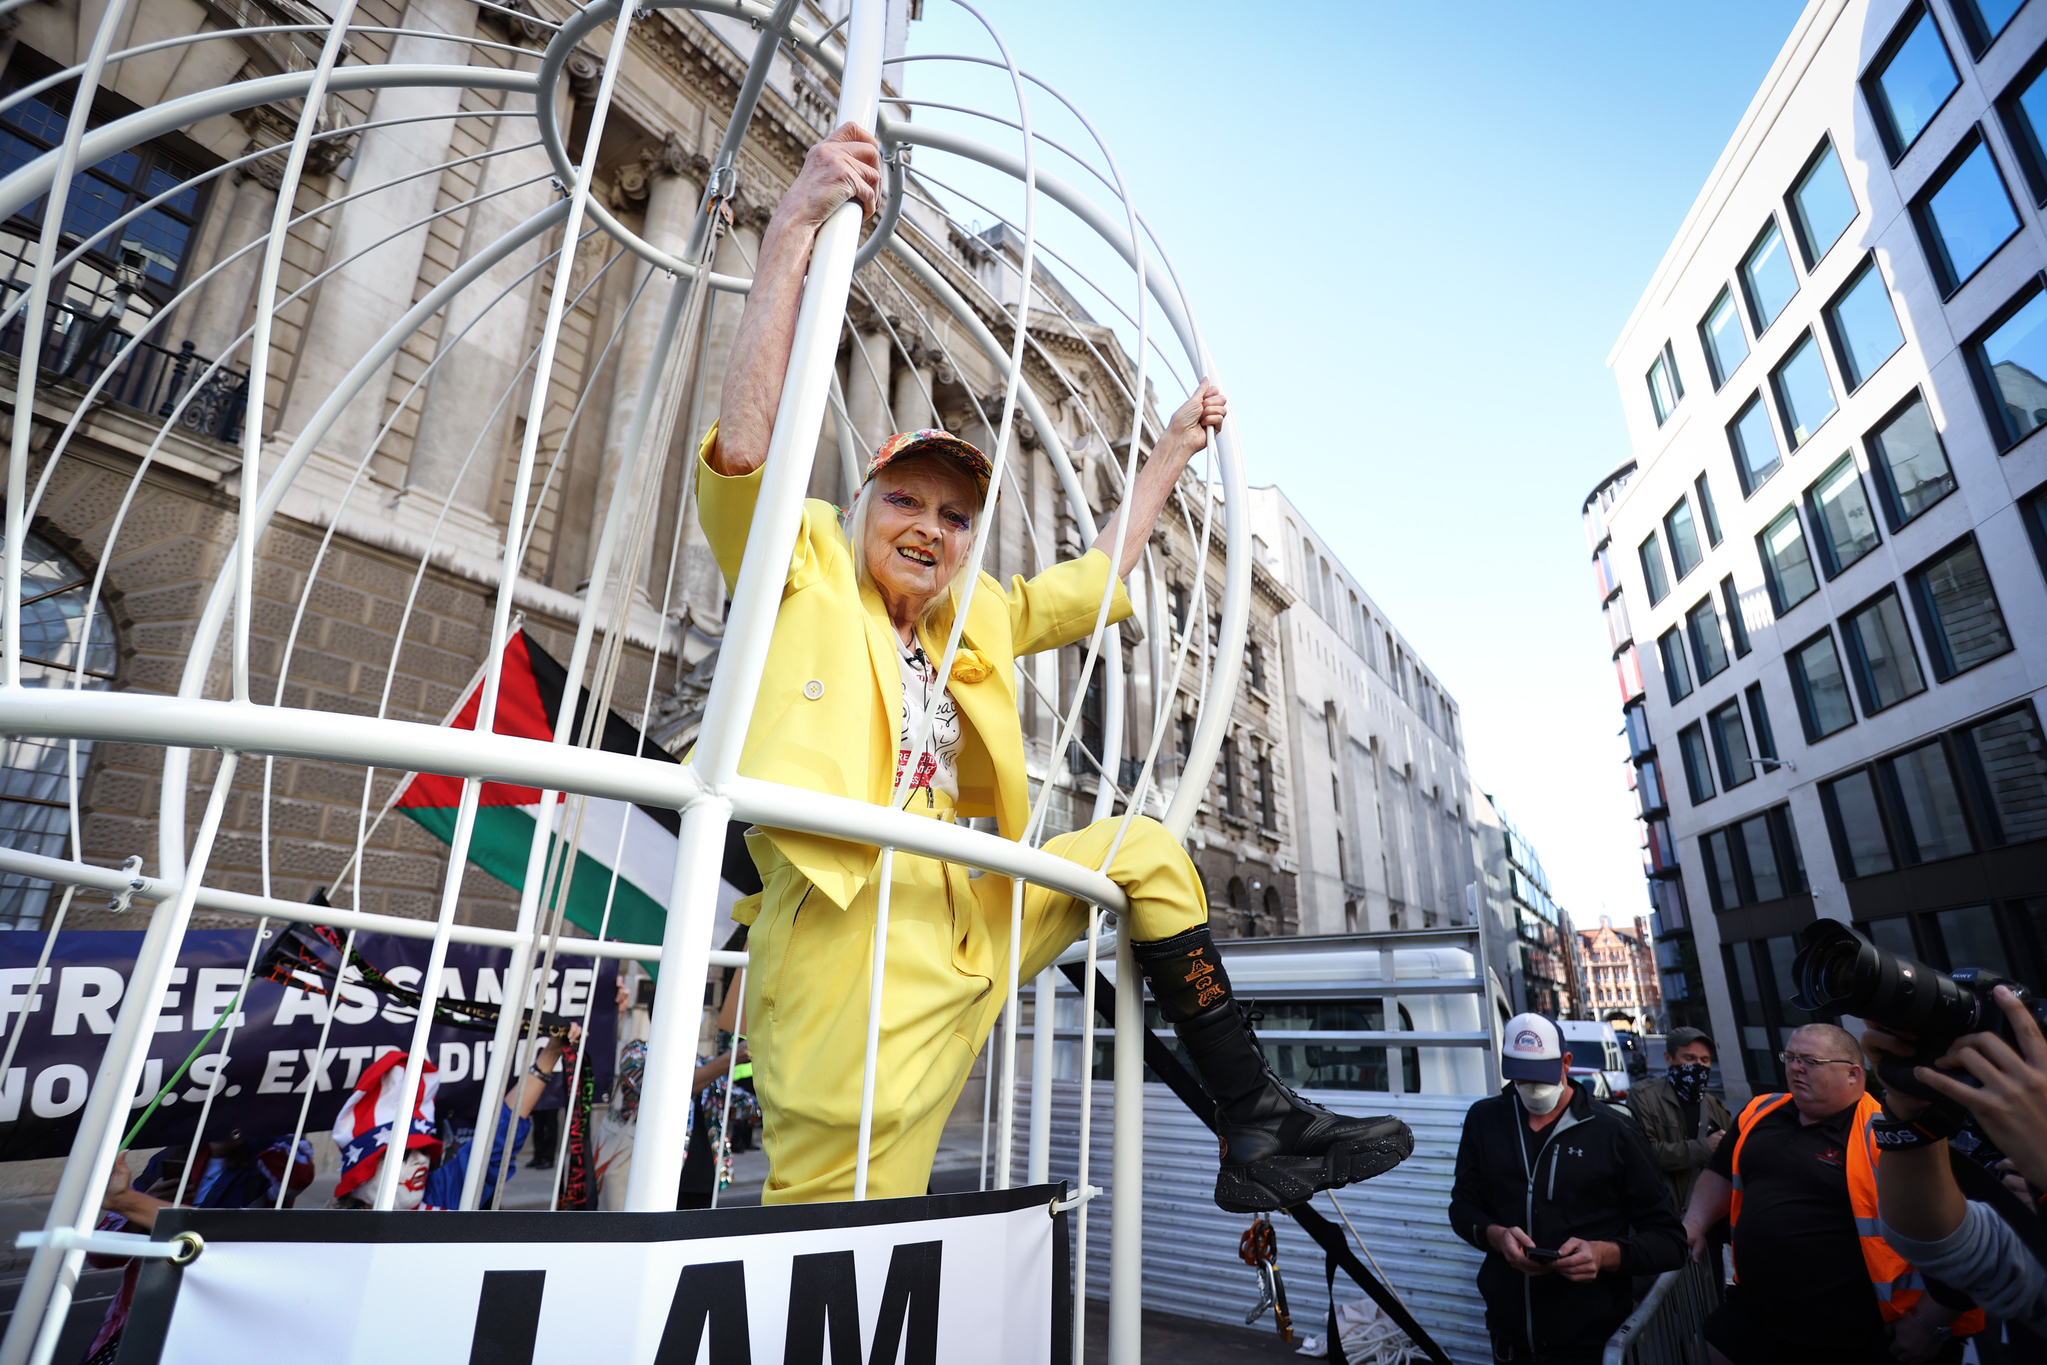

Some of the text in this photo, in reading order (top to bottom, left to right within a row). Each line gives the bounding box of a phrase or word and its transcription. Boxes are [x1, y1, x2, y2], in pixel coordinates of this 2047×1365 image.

[714, 129, 771, 189] DFEND
[256, 1036, 563, 1095] EXTDII
[1875, 1130, 1917, 1145] SON
